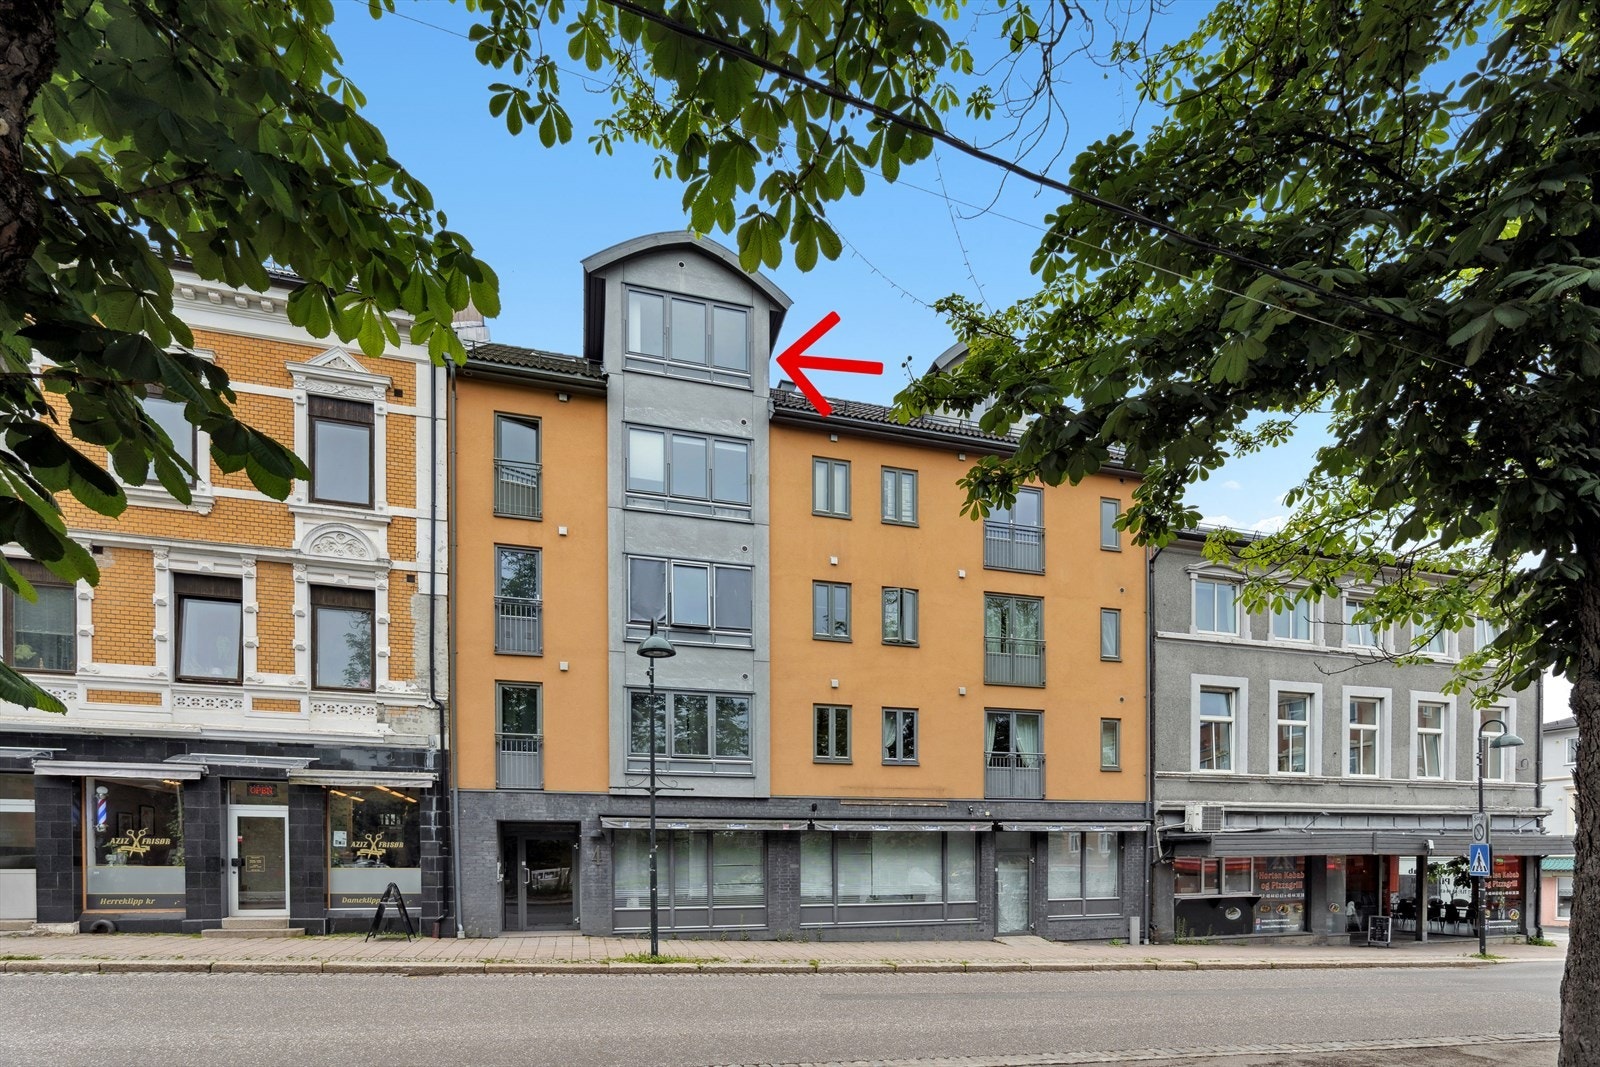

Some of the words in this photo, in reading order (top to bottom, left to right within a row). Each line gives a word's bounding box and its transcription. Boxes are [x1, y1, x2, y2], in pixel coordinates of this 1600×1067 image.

[249, 786, 273, 795] OPEN
[592, 845, 602, 866] 4
[1261, 882, 1269, 890] og
[1272, 881, 1302, 890] Pizzagrill
[100, 897, 143, 906] Herreklipp
